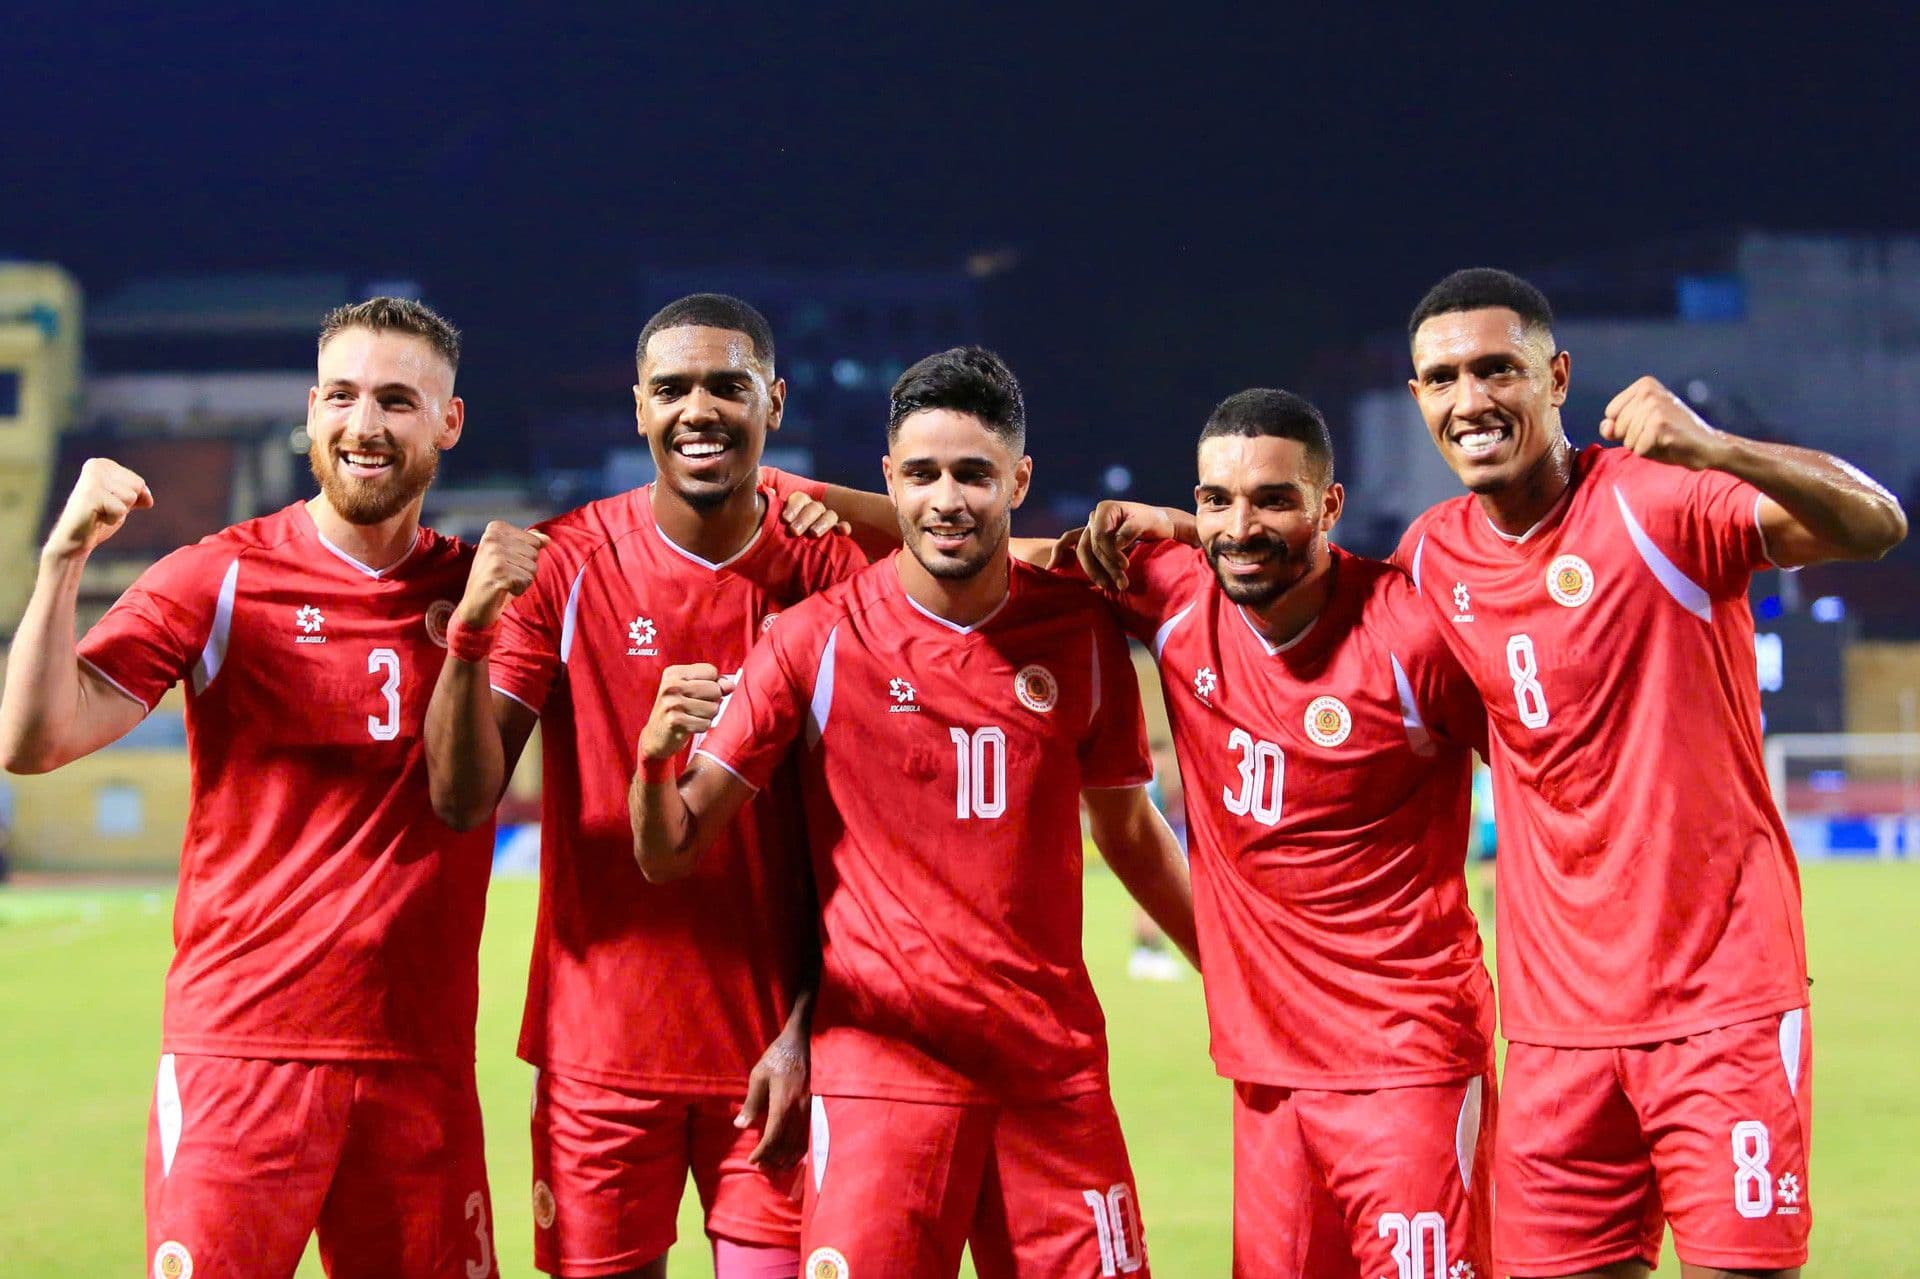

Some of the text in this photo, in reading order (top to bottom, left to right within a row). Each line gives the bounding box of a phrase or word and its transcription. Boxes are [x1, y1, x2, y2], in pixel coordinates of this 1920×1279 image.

[368, 648, 400, 741] 3
[1506, 633, 1549, 729] 8
[949, 726, 1006, 819] 10
[1223, 728, 1285, 826] 30
[1732, 1120, 1772, 1218] 8
[465, 1190, 491, 1279] 3
[1082, 1182, 1142, 1277] 10
[1378, 1211, 1447, 1279] 30
